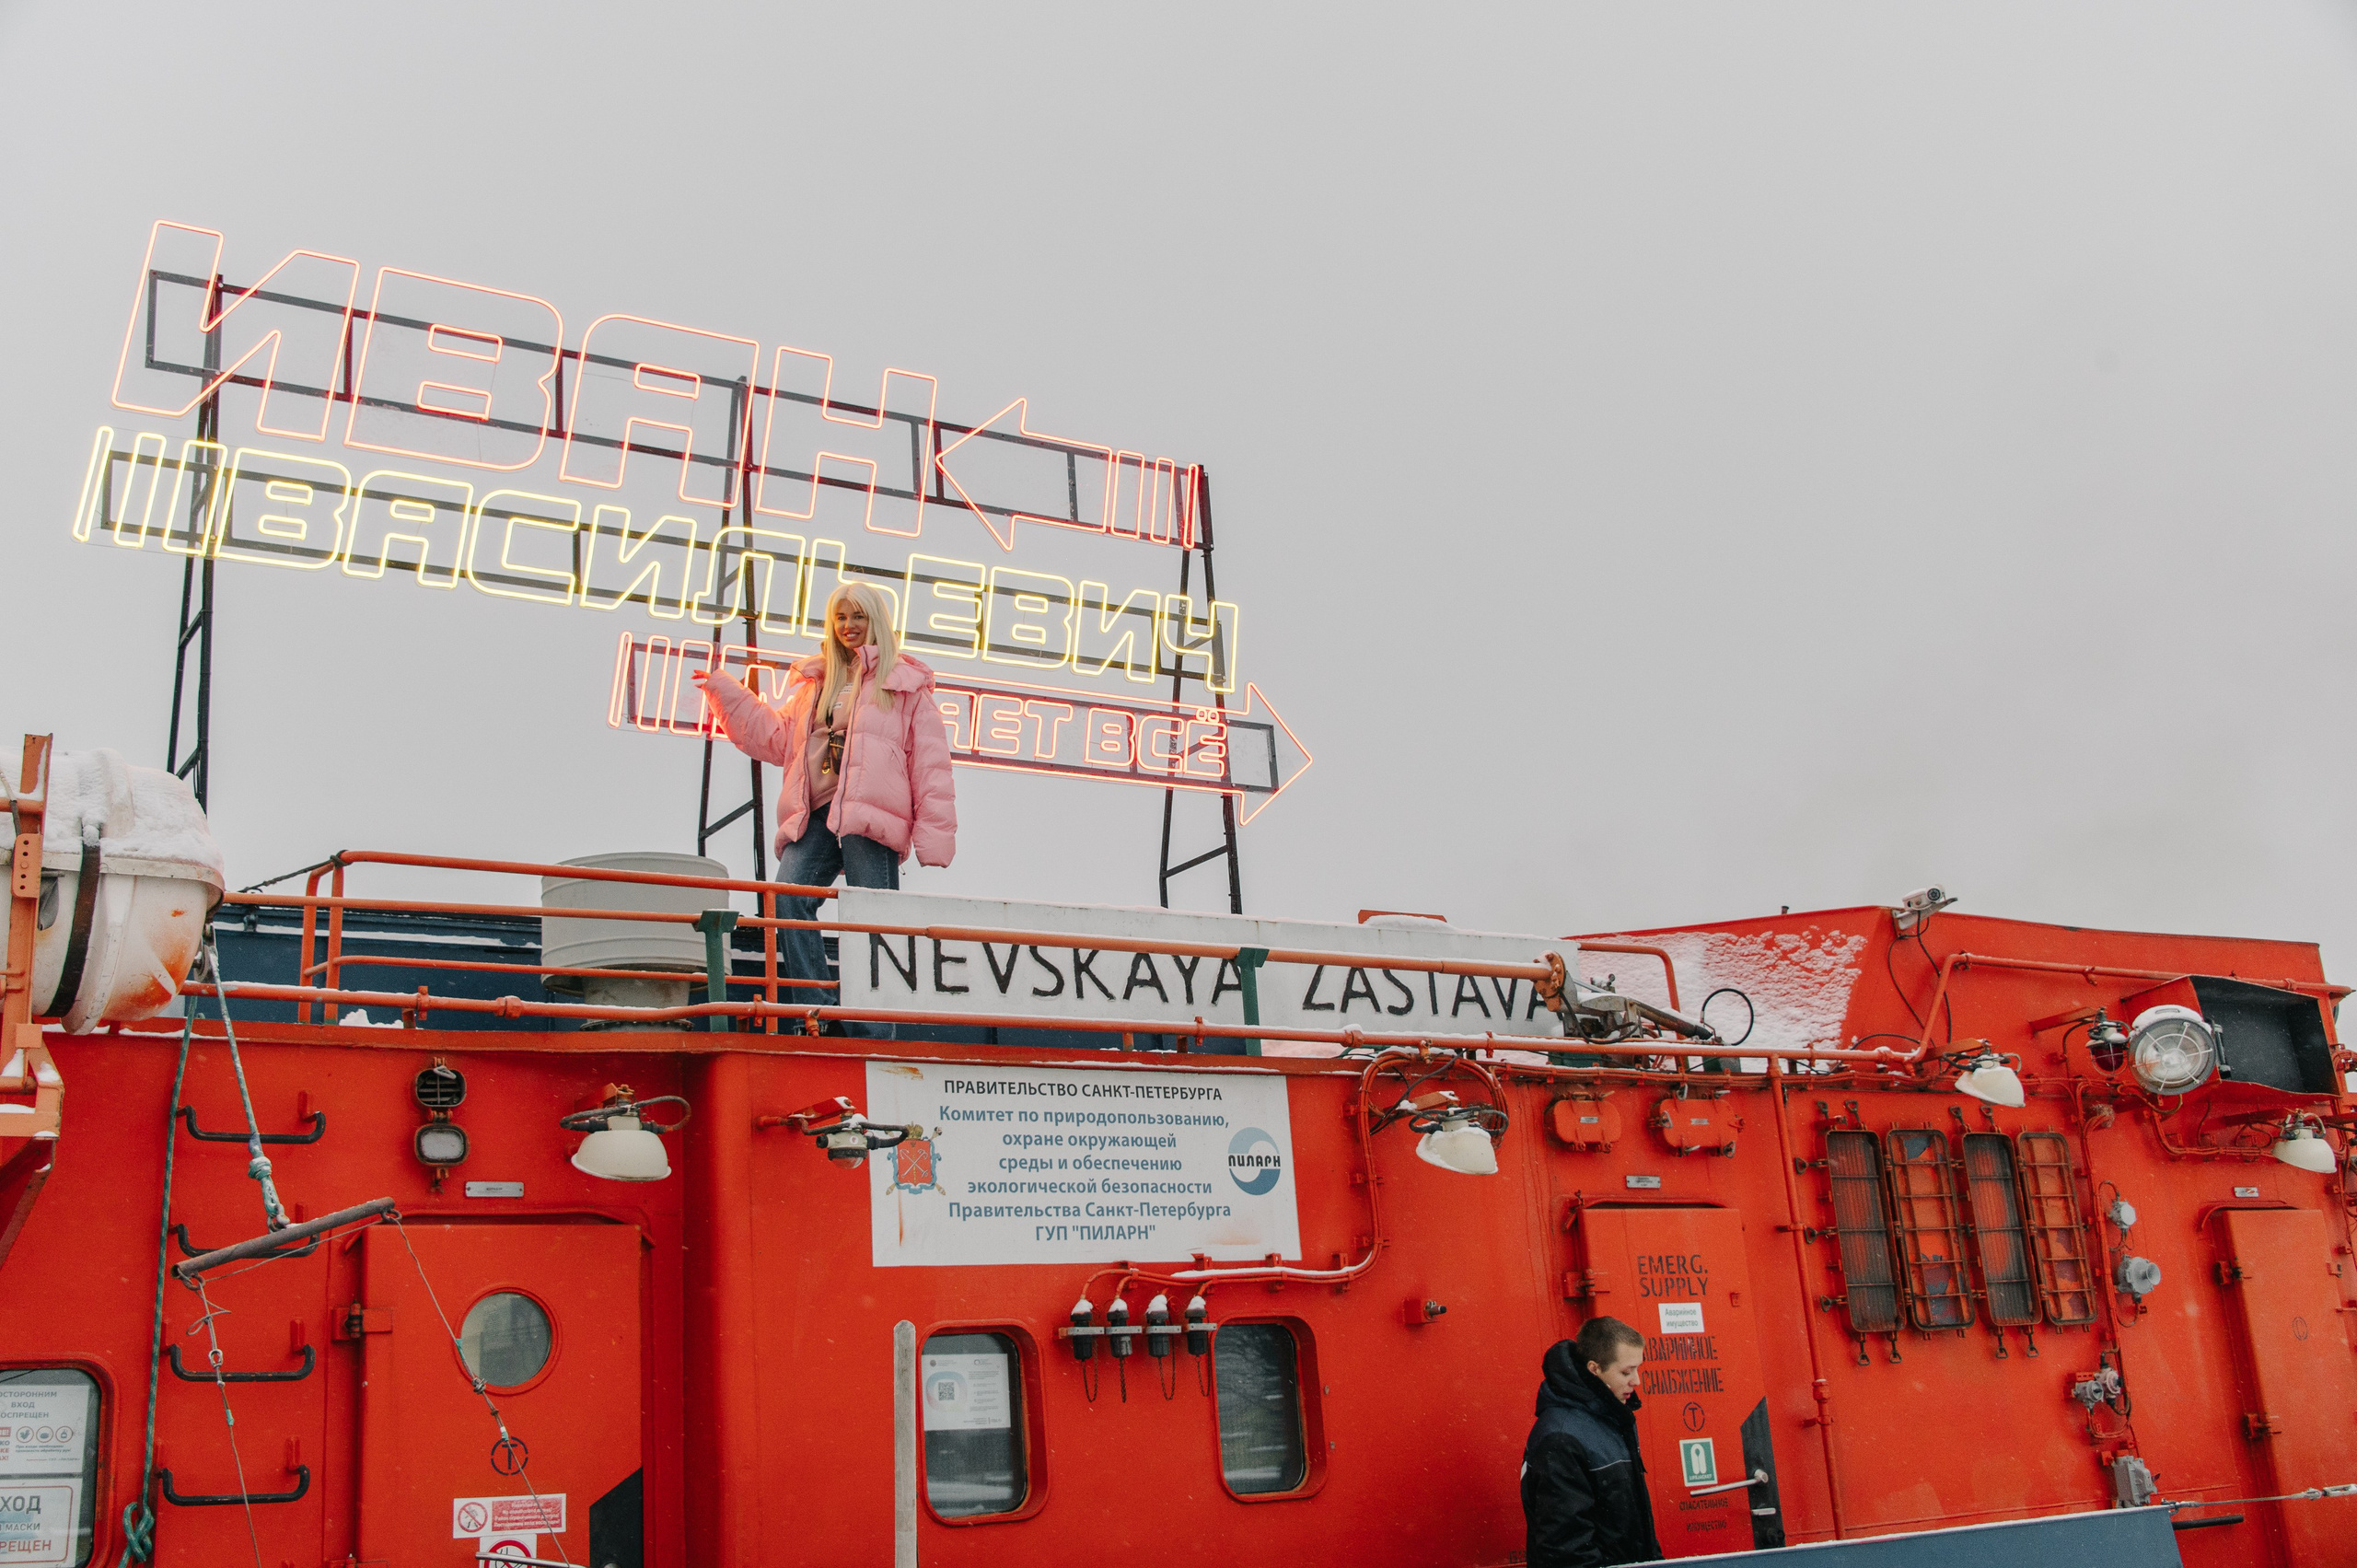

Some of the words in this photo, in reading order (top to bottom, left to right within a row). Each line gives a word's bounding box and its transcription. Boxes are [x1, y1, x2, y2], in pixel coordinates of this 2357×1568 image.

[112, 219, 937, 538] ИВАН
[1084, 706, 1228, 777] ВСЁ
[944, 1079, 1078, 1097] ПРАВИТЕЛЬСТВО
[1081, 1084, 1223, 1101] САНКТ-ПЕТЕРБУРГА
[939, 1105, 1014, 1121] Комитет
[1018, 1110, 1039, 1122] по
[1043, 1110, 1230, 1128] природопользованию,
[1002, 1133, 1063, 1149] охране
[1068, 1132, 1177, 1151] окружающей
[999, 1156, 1053, 1173] среды
[1058, 1157, 1068, 1170] и
[1073, 1154, 1182, 1171] обеспечению
[1228, 1154, 1281, 1167] ПИЛАРН
[967, 1178, 1097, 1195] экологической
[1101, 1179, 1213, 1195] безопасности
[948, 1202, 1081, 1222] Правительства
[1085, 1201, 1232, 1221] Санкт-Петербурга
[1035, 1225, 1068, 1241] ГУП
[1072, 1225, 1155, 1241] "ПИЛАРН"
[1636, 1254, 1709, 1275] EMERG.
[1639, 1277, 1709, 1298] SUPPLY
[1665, 1307, 1697, 1318] Аварийное
[1666, 1319, 1699, 1329] имущество
[1641, 1367, 1724, 1395] СНАБЖЕНИЕ
[6, 1523, 41, 1531] МАСКИ
